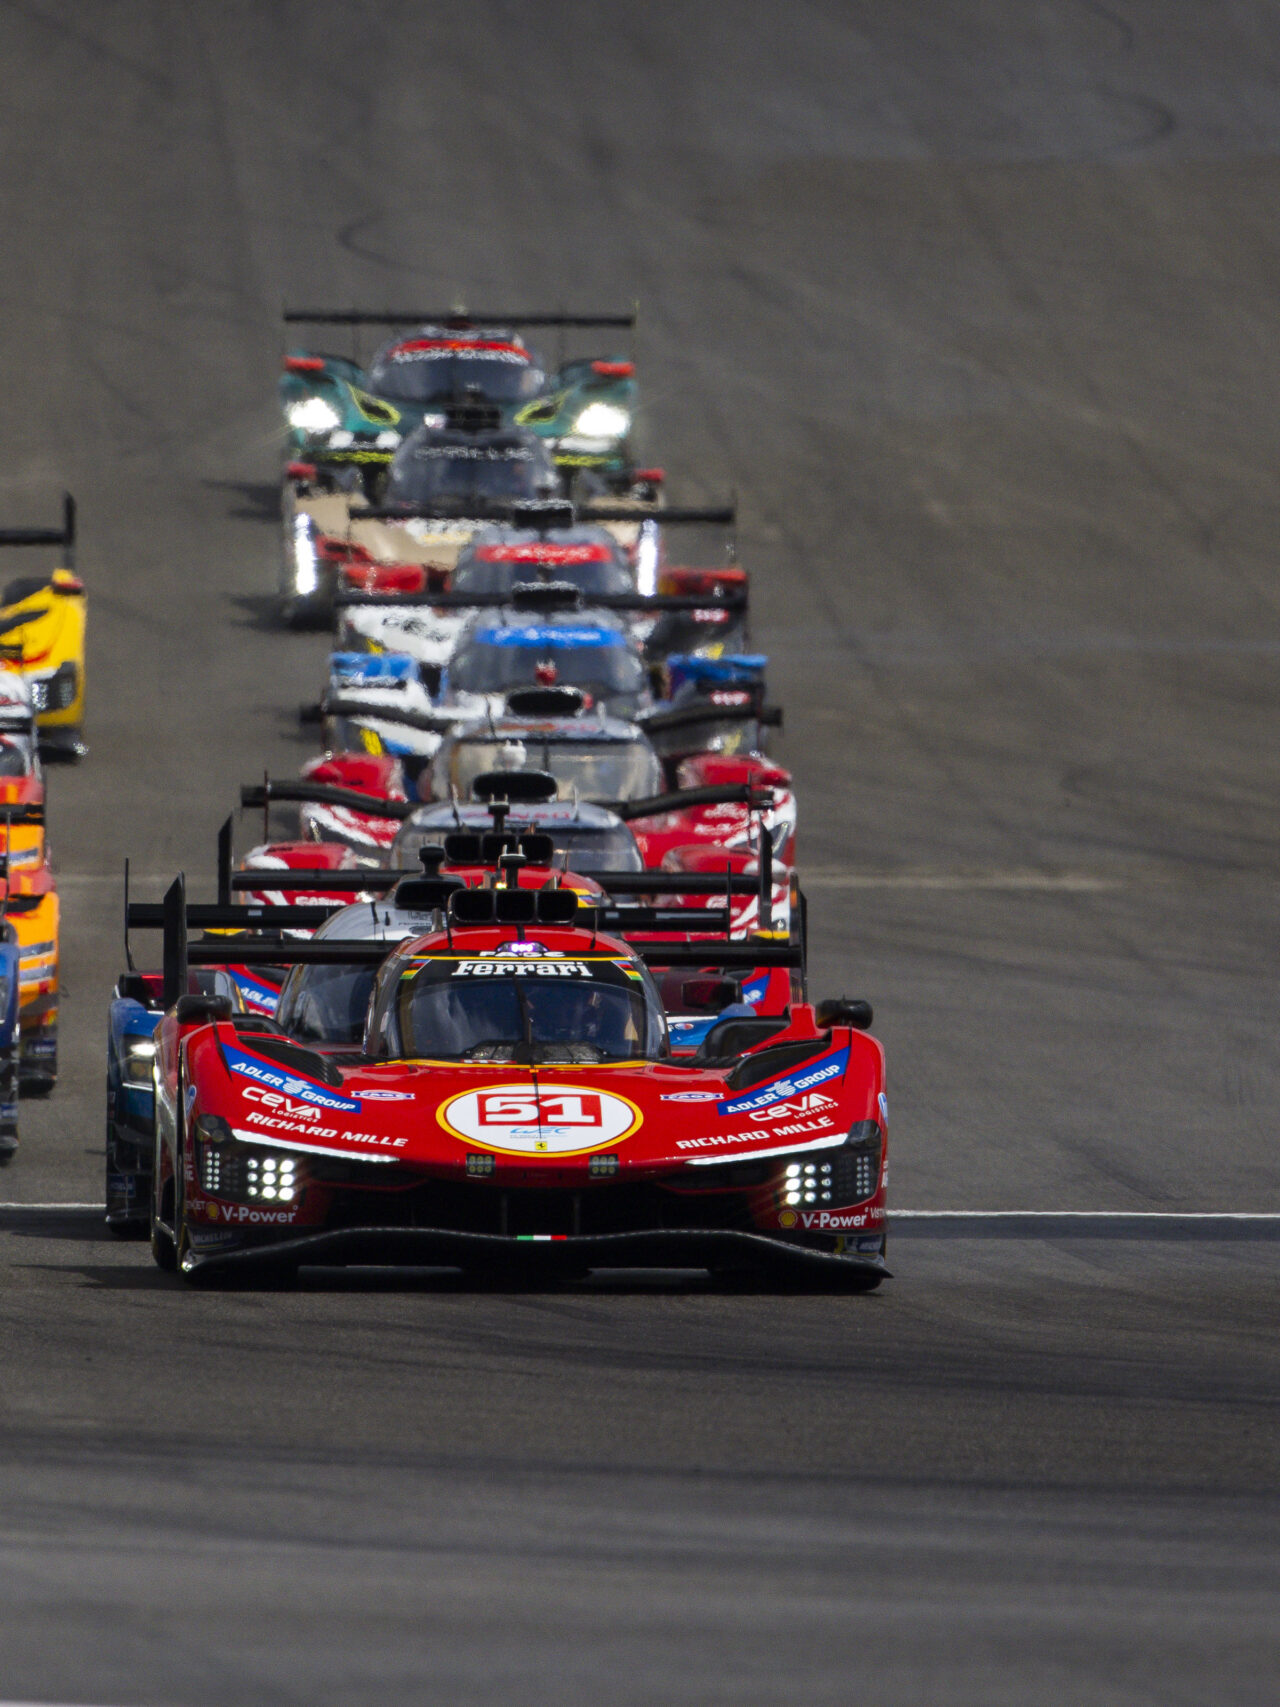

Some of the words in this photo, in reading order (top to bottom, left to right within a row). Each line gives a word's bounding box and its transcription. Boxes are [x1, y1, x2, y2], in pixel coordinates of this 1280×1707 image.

[451, 960, 593, 977] Ferrari
[231, 1062, 287, 1087] ADLER
[299, 1091, 356, 1111] GROUP
[726, 1091, 779, 1113] ADLER
[795, 1064, 841, 1089] GROUP
[271, 1108, 318, 1123] LOGISTICS
[485, 1096, 595, 1123] 51
[794, 1101, 839, 1119] LOGISTICS
[245, 1112, 338, 1138] RICHARD
[340, 1131, 409, 1147] MILLE
[676, 1130, 770, 1150] RICHARD
[772, 1116, 835, 1137] MILLE
[221, 1205, 297, 1223] V-Power
[802, 1212, 868, 1228] V-Power
